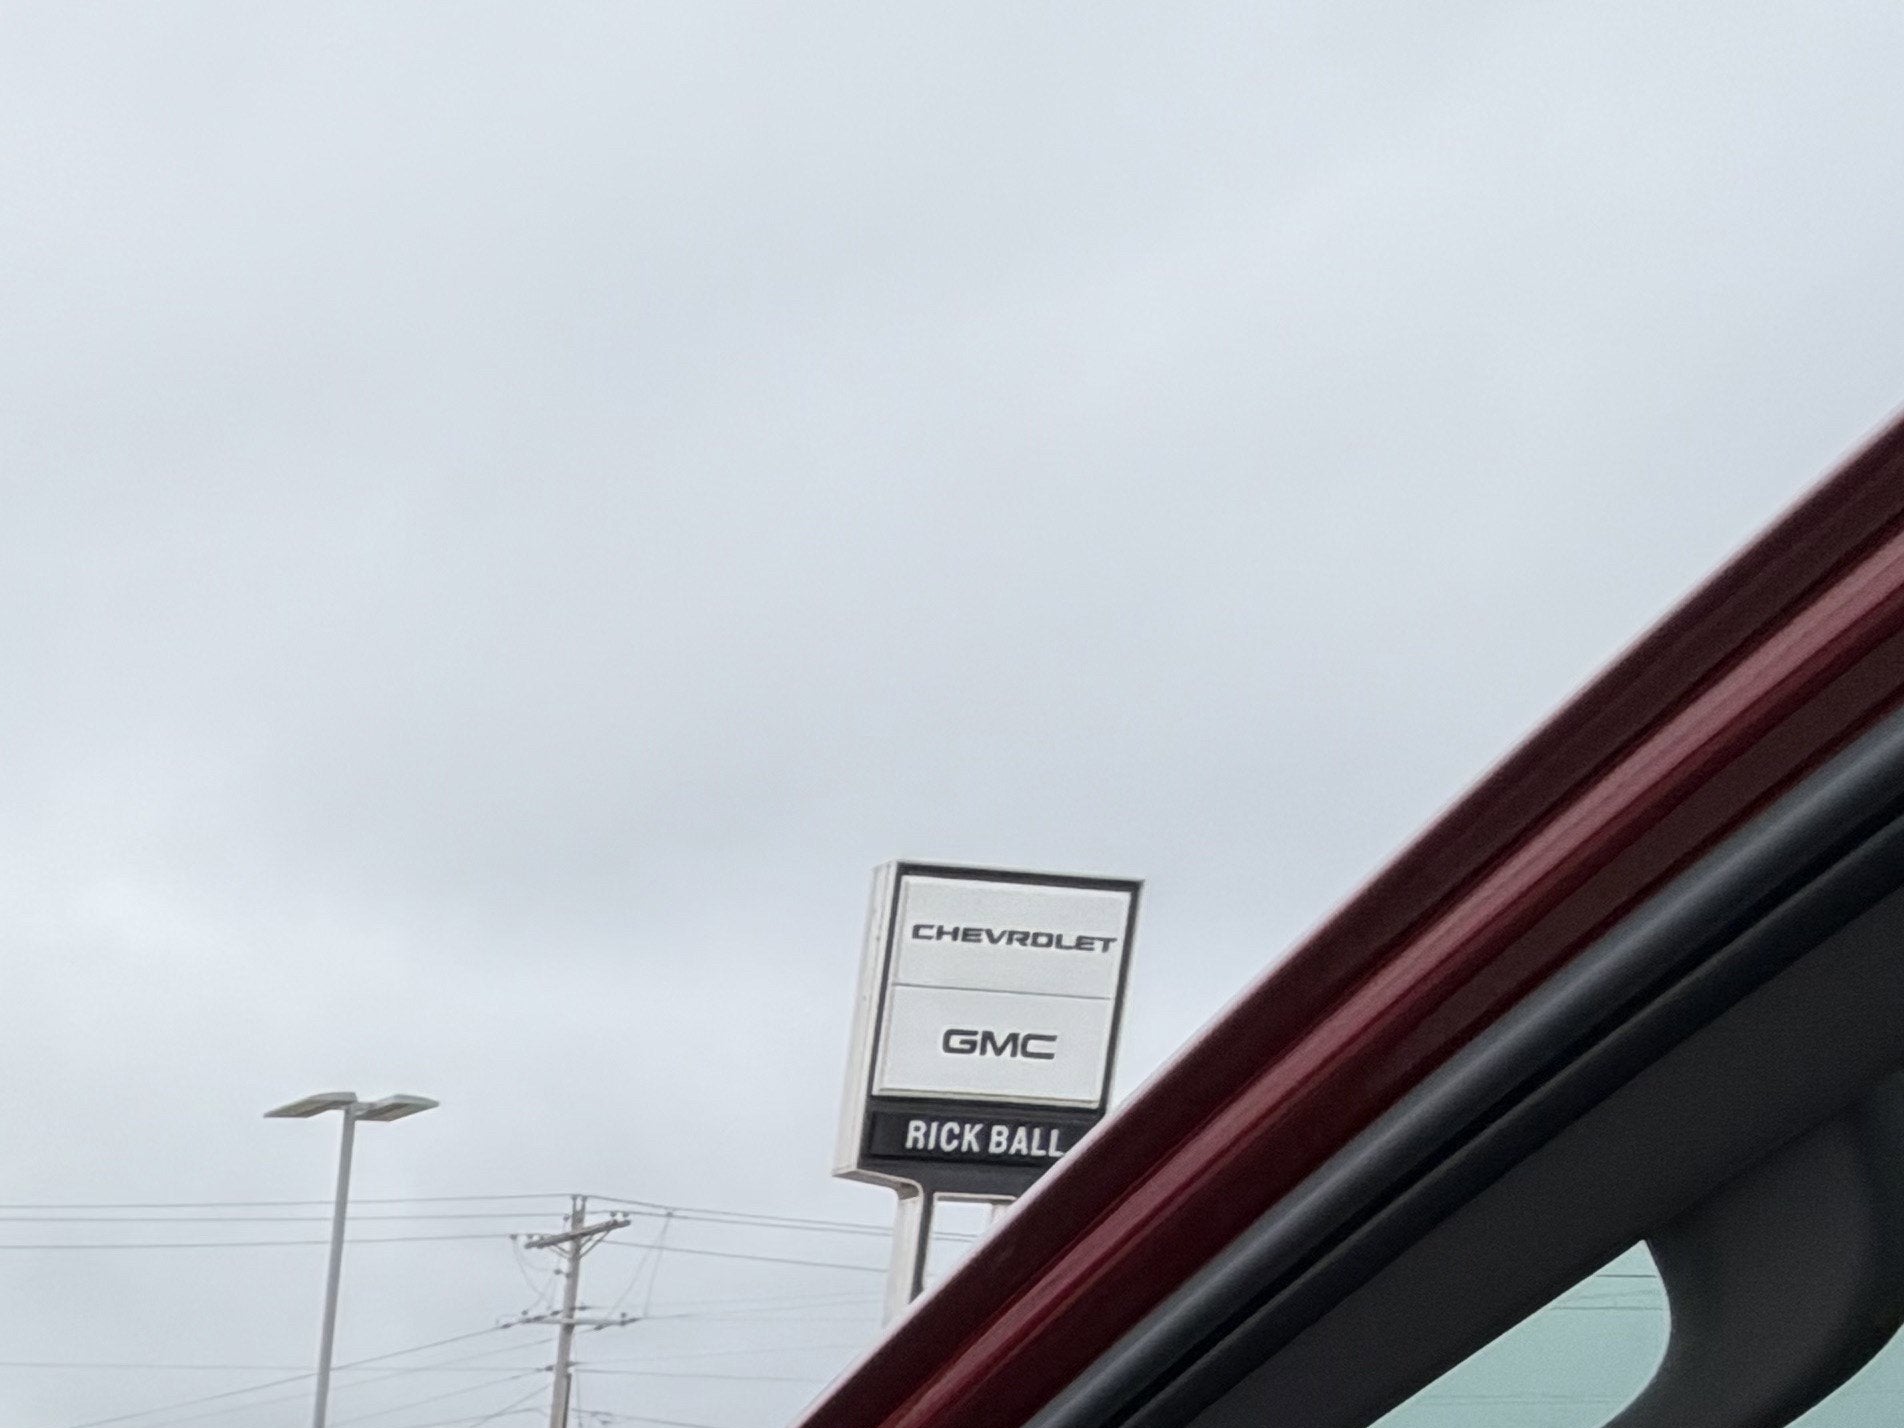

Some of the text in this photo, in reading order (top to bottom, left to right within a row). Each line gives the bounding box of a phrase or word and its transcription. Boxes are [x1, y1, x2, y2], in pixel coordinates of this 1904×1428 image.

[912, 924, 1117, 953] CHEVROLET
[942, 1029, 1058, 1060] GMC
[905, 1119, 1067, 1158] RICK BALL
